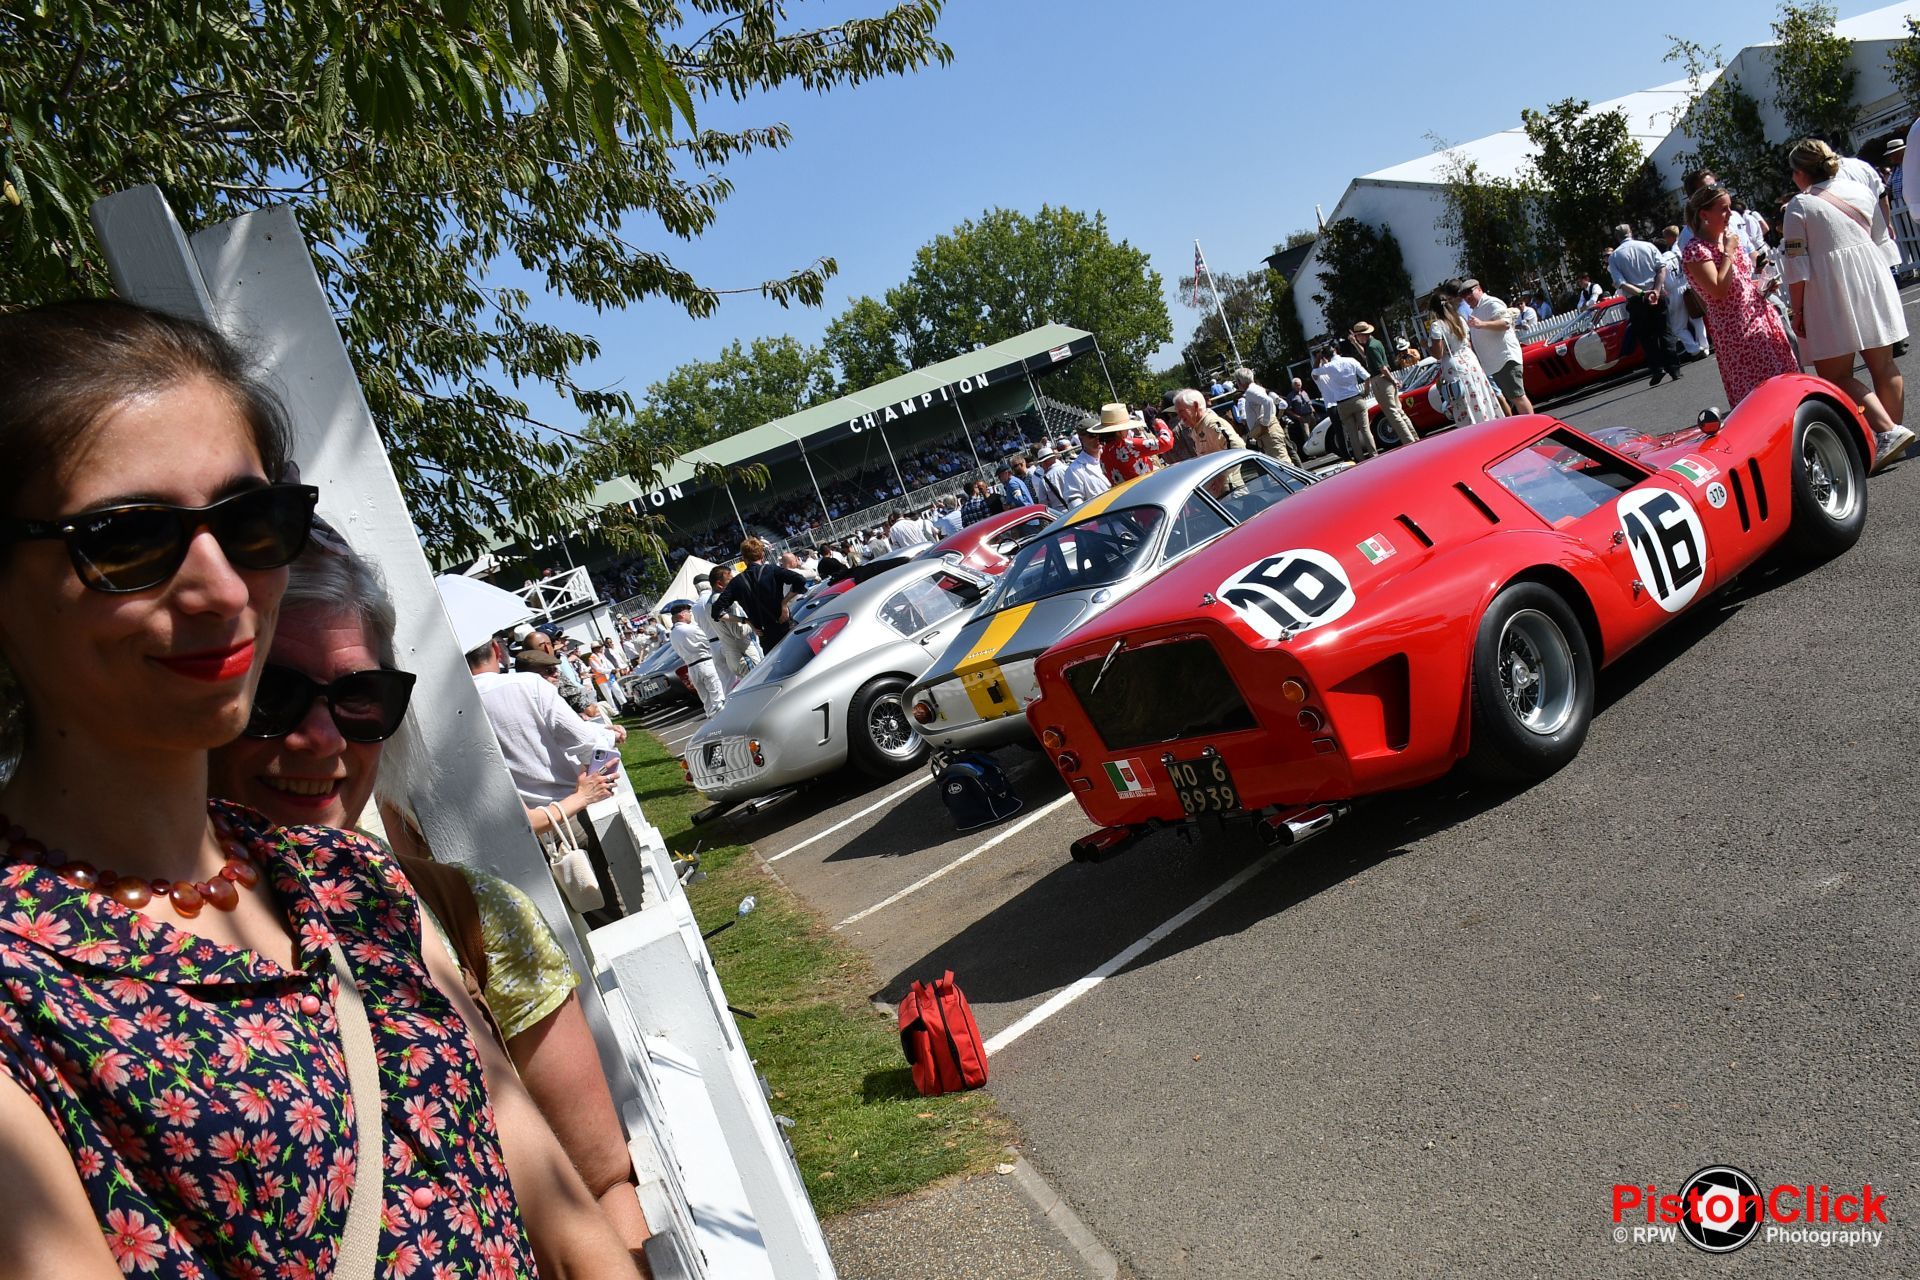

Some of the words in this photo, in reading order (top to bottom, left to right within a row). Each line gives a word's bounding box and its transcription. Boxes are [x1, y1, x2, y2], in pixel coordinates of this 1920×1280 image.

[850, 373, 989, 433] CHAMPION
[1710, 486, 1725, 503] 378
[1622, 492, 1702, 601] 16
[1222, 557, 1347, 630] 16
[1168, 764, 1198, 788] MO
[1212, 759, 1226, 781] 6
[1181, 786, 1234, 813] 8939
